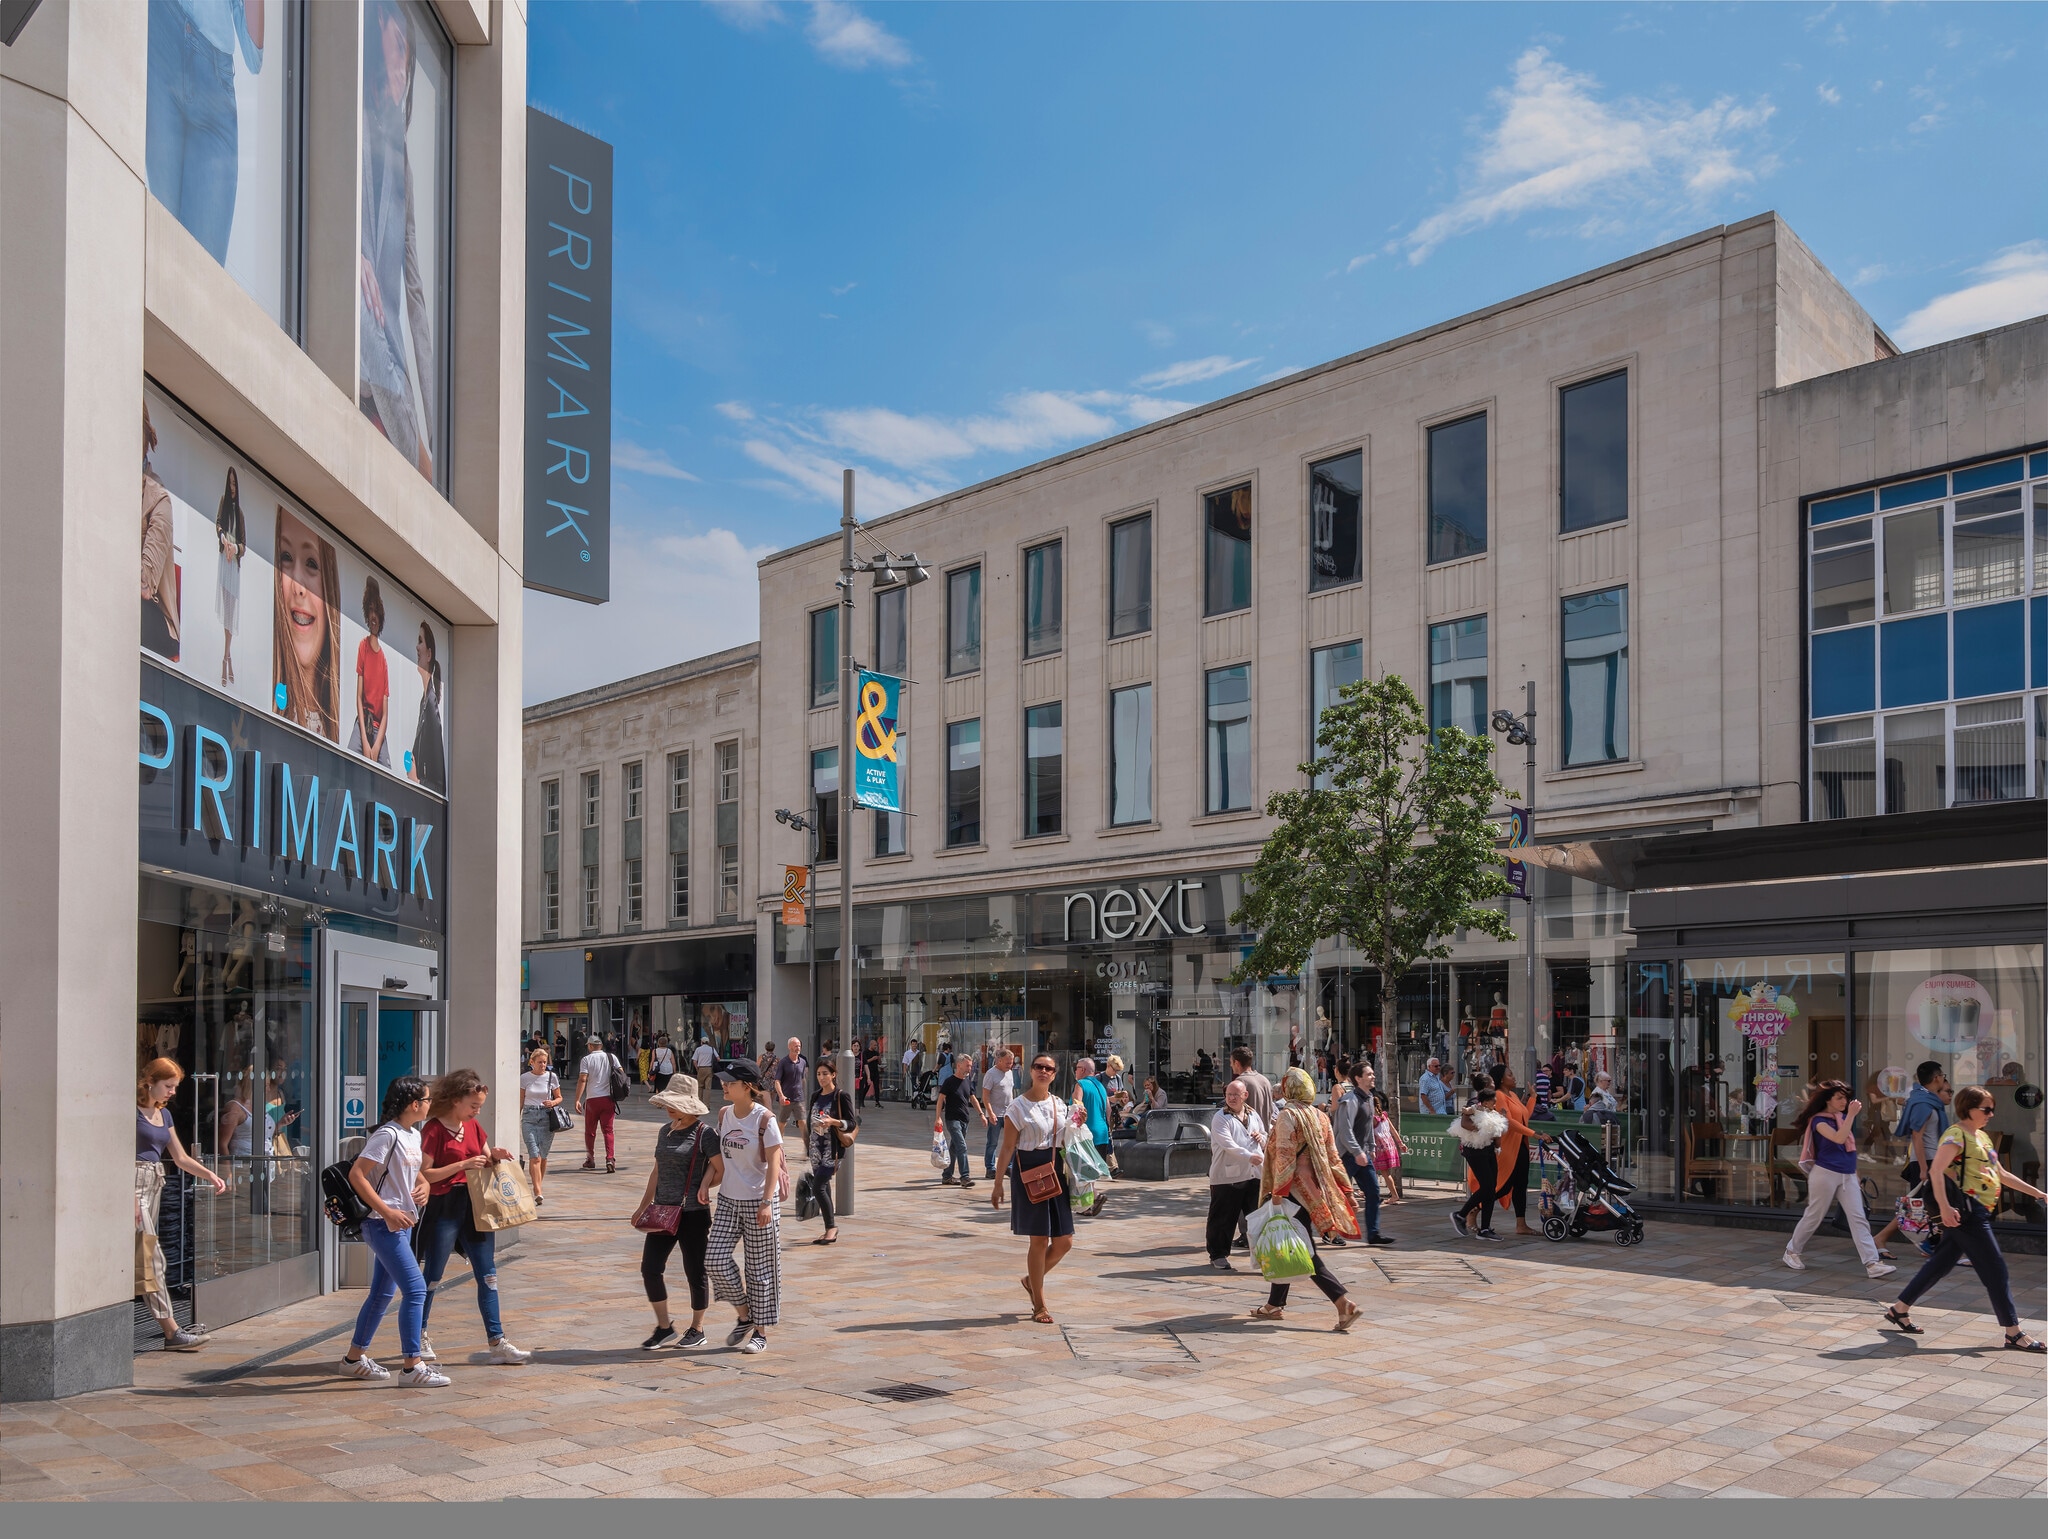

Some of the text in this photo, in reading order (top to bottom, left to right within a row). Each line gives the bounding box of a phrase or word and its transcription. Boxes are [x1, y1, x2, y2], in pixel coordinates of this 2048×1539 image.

[866, 768, 886, 778] ACTIVE
[872, 776, 886, 785] PLAY
[139, 700, 434, 900] PRIMARK
[1064, 880, 1206, 942] next
[1096, 961, 1148, 978] COSTA
[1109, 981, 1137, 989] COFFEE
[1925, 980, 1976, 989] ENJOY SUMMER
[1741, 1012, 1786, 1022] THROW
[1741, 1022, 1785, 1035] BACK
[1748, 1036, 1779, 1050] Party
[1403, 1148, 1443, 1158] OFFEE
